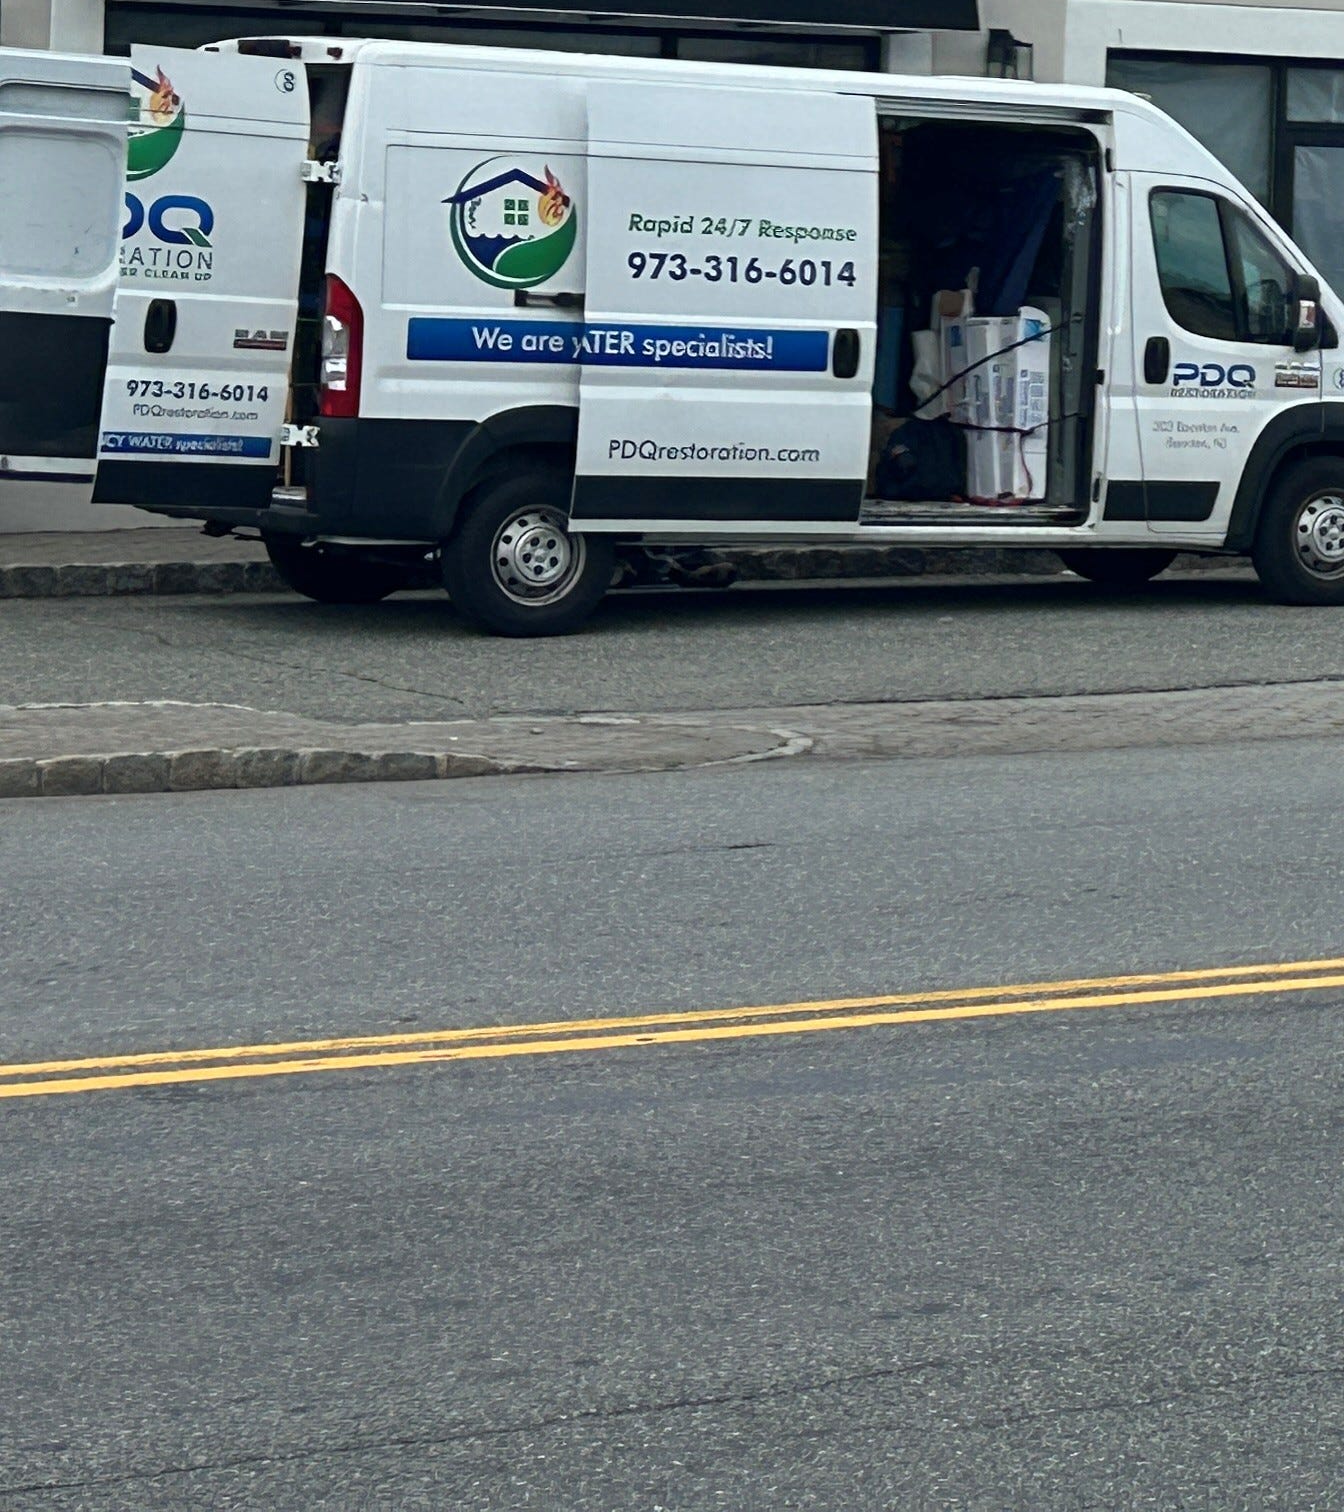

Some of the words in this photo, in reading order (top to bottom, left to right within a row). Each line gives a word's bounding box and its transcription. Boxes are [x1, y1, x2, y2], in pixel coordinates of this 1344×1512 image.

[628, 213, 695, 237] Rapid
[700, 216, 752, 237] 24/7
[758, 219, 857, 243] Response
[627, 251, 857, 287] 973-316-6014
[471, 326, 513, 352] We
[521, 334, 565, 353] are
[641, 333, 774, 362] specialists!
[1172, 362, 1257, 388] PDQ
[126, 378, 270, 403] 973-316-6014
[608, 439, 821, 464] PDQrestoration.com
